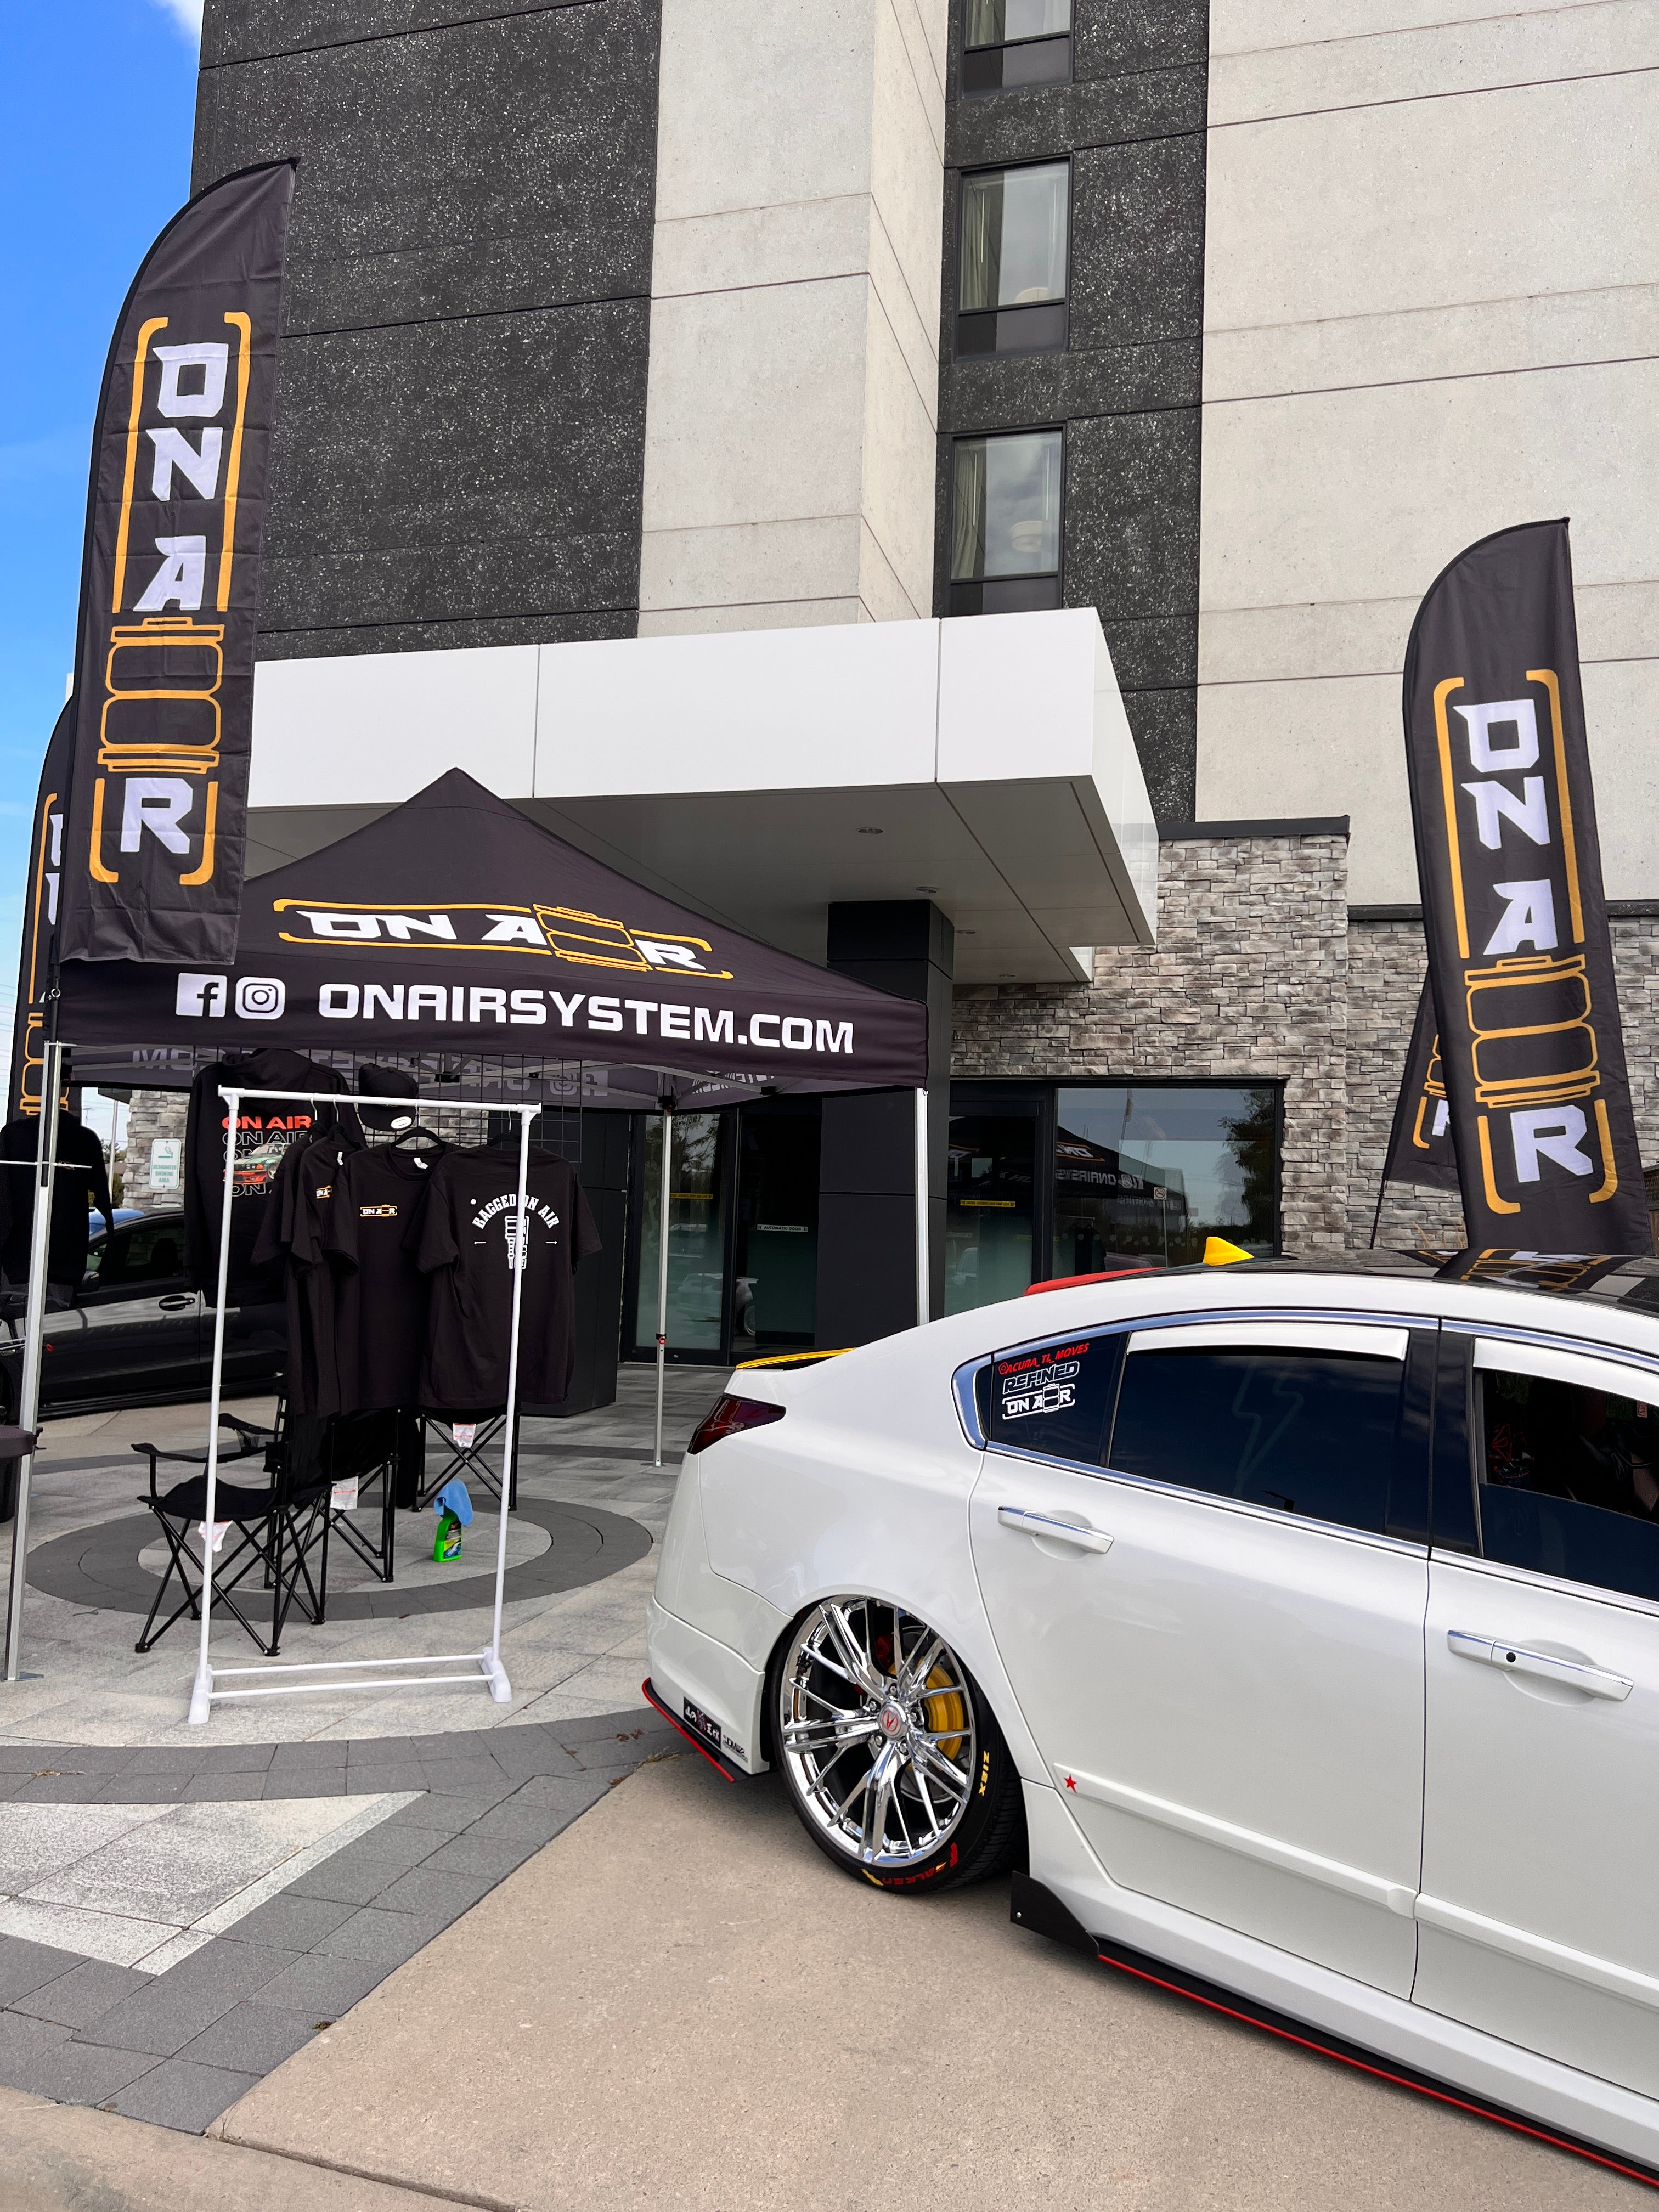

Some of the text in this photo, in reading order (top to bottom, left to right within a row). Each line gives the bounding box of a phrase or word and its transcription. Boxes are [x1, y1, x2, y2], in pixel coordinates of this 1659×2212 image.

[296, 910, 457, 940] ON
[318, 984, 854, 1054] ONAIRSYSTEM.COM
[222, 1115, 312, 1130] ON AIR
[472, 1194, 517, 1229] BAGGED
[537, 1205, 560, 1229] AIR
[1002, 1361, 1080, 1395] REFINED
[1006, 1398, 1029, 1414] ON
[978, 1750, 990, 1796] ZIEX
